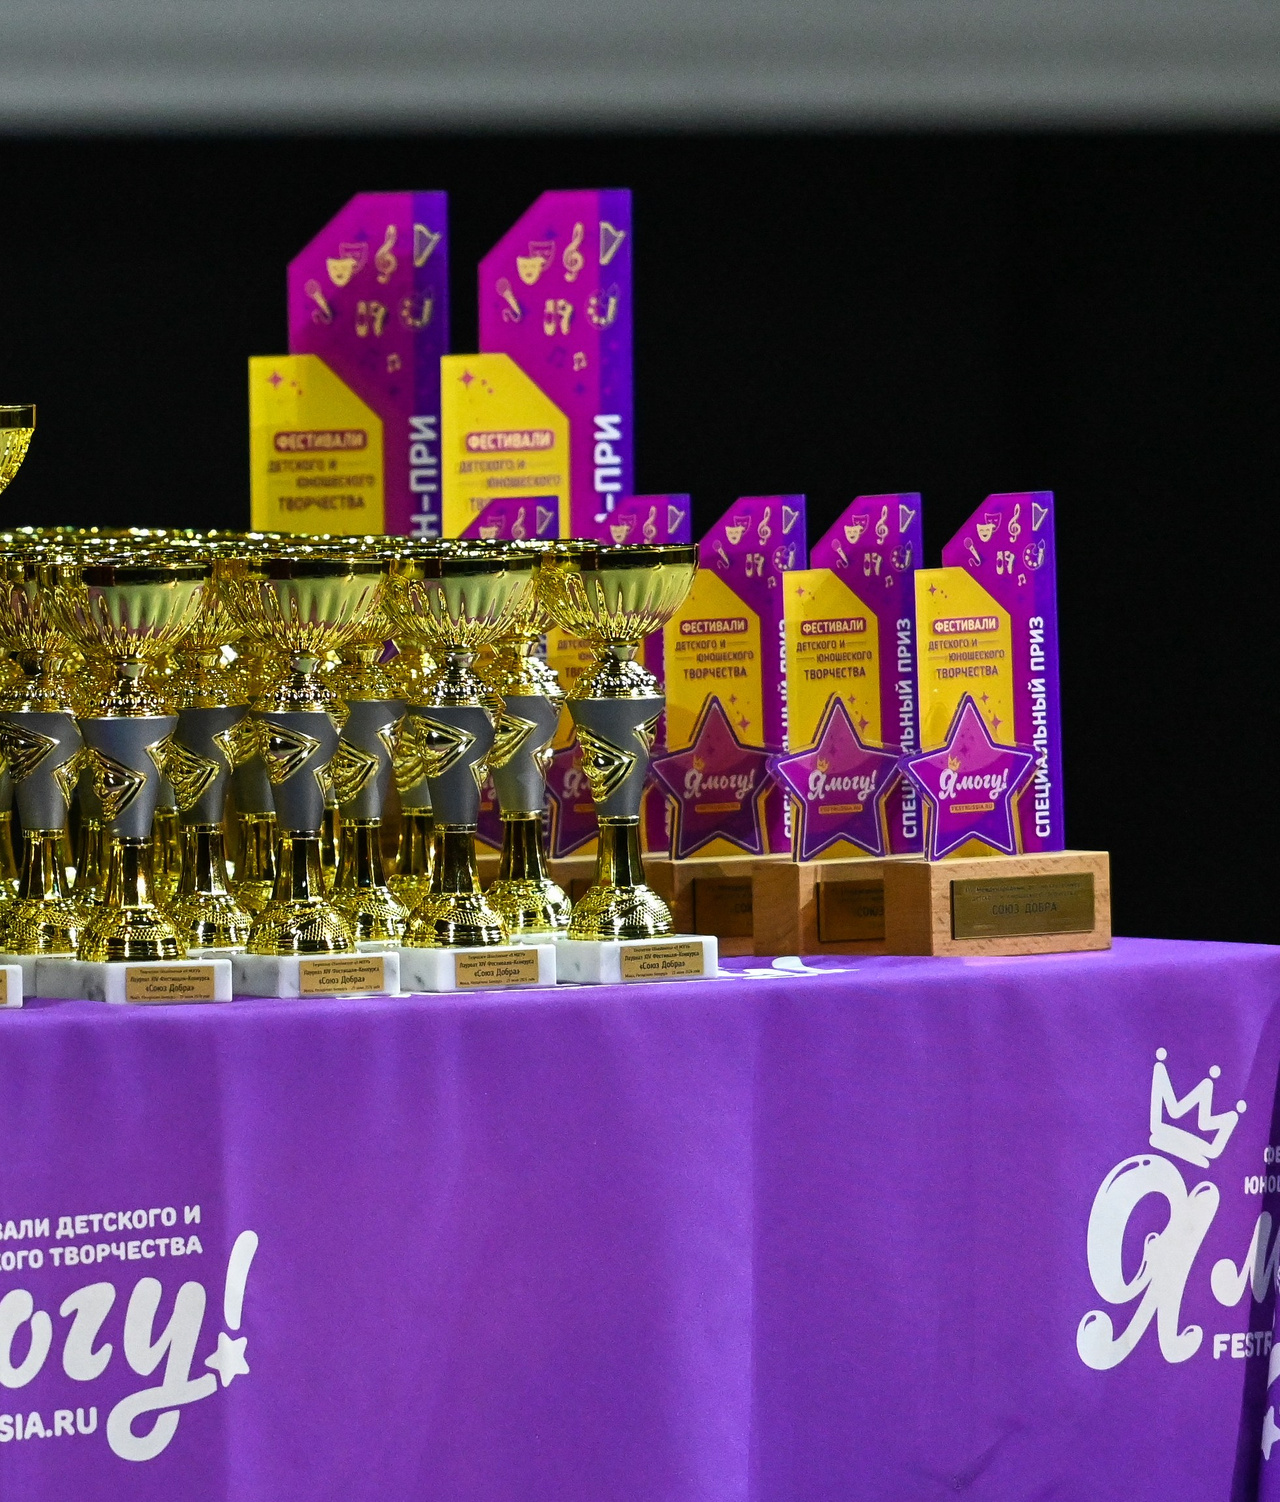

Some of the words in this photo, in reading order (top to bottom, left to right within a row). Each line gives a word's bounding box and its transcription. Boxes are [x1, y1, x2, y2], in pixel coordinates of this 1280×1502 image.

[276, 432, 363, 450] ФЕСТИВАЛИ
[468, 431, 552, 450] ФЕСТИВАЛИ
[682, 620, 745, 633] ФЕСТИВАЛИ
[803, 619, 864, 634] ФЕСТИВАЛИ
[934, 617, 996, 632] ФЕСТИВАЛИ
[675, 640, 717, 651] ДЕТСКОГО
[720, 639, 726, 648] И
[796, 640, 837, 653] ДЕТСКОГО
[839, 639, 845, 648] И
[896, 618, 912, 672] ПРИЗ
[928, 639, 969, 651] ДЕТСКОГО
[972, 638, 978, 647] И
[1029, 616, 1046, 672] ПРИЗ
[696, 650, 754, 663] ЮНОШЕСКОГО
[816, 650, 873, 663] ЮНОШЕСКОГО
[948, 649, 1005, 662] ЮНОШЕСКОГО
[684, 666, 747, 679] ТВОРЧЕСТВА
[804, 666, 866, 680] ТВОРЧЕСТВА
[936, 665, 999, 679] ТВОРЧЕСТВА
[992, 904, 1020, 916] СОЮЗ
[1025, 902, 1057, 914] ДОБРА
[639, 961, 660, 970] «Союз
[661, 959, 685, 970] Добра»
[474, 969, 494, 977] «Союз
[495, 967, 520, 977] Добра»
[319, 977, 339, 985] «Союз
[340, 975, 365, 985] Добра»
[169, 983, 195, 992] Добра»
[55, 1207, 177, 1240] ДЕТСКОГО
[184, 1205, 201, 1225] И
[50, 1235, 203, 1268] ТВОРЧЕСТВА
